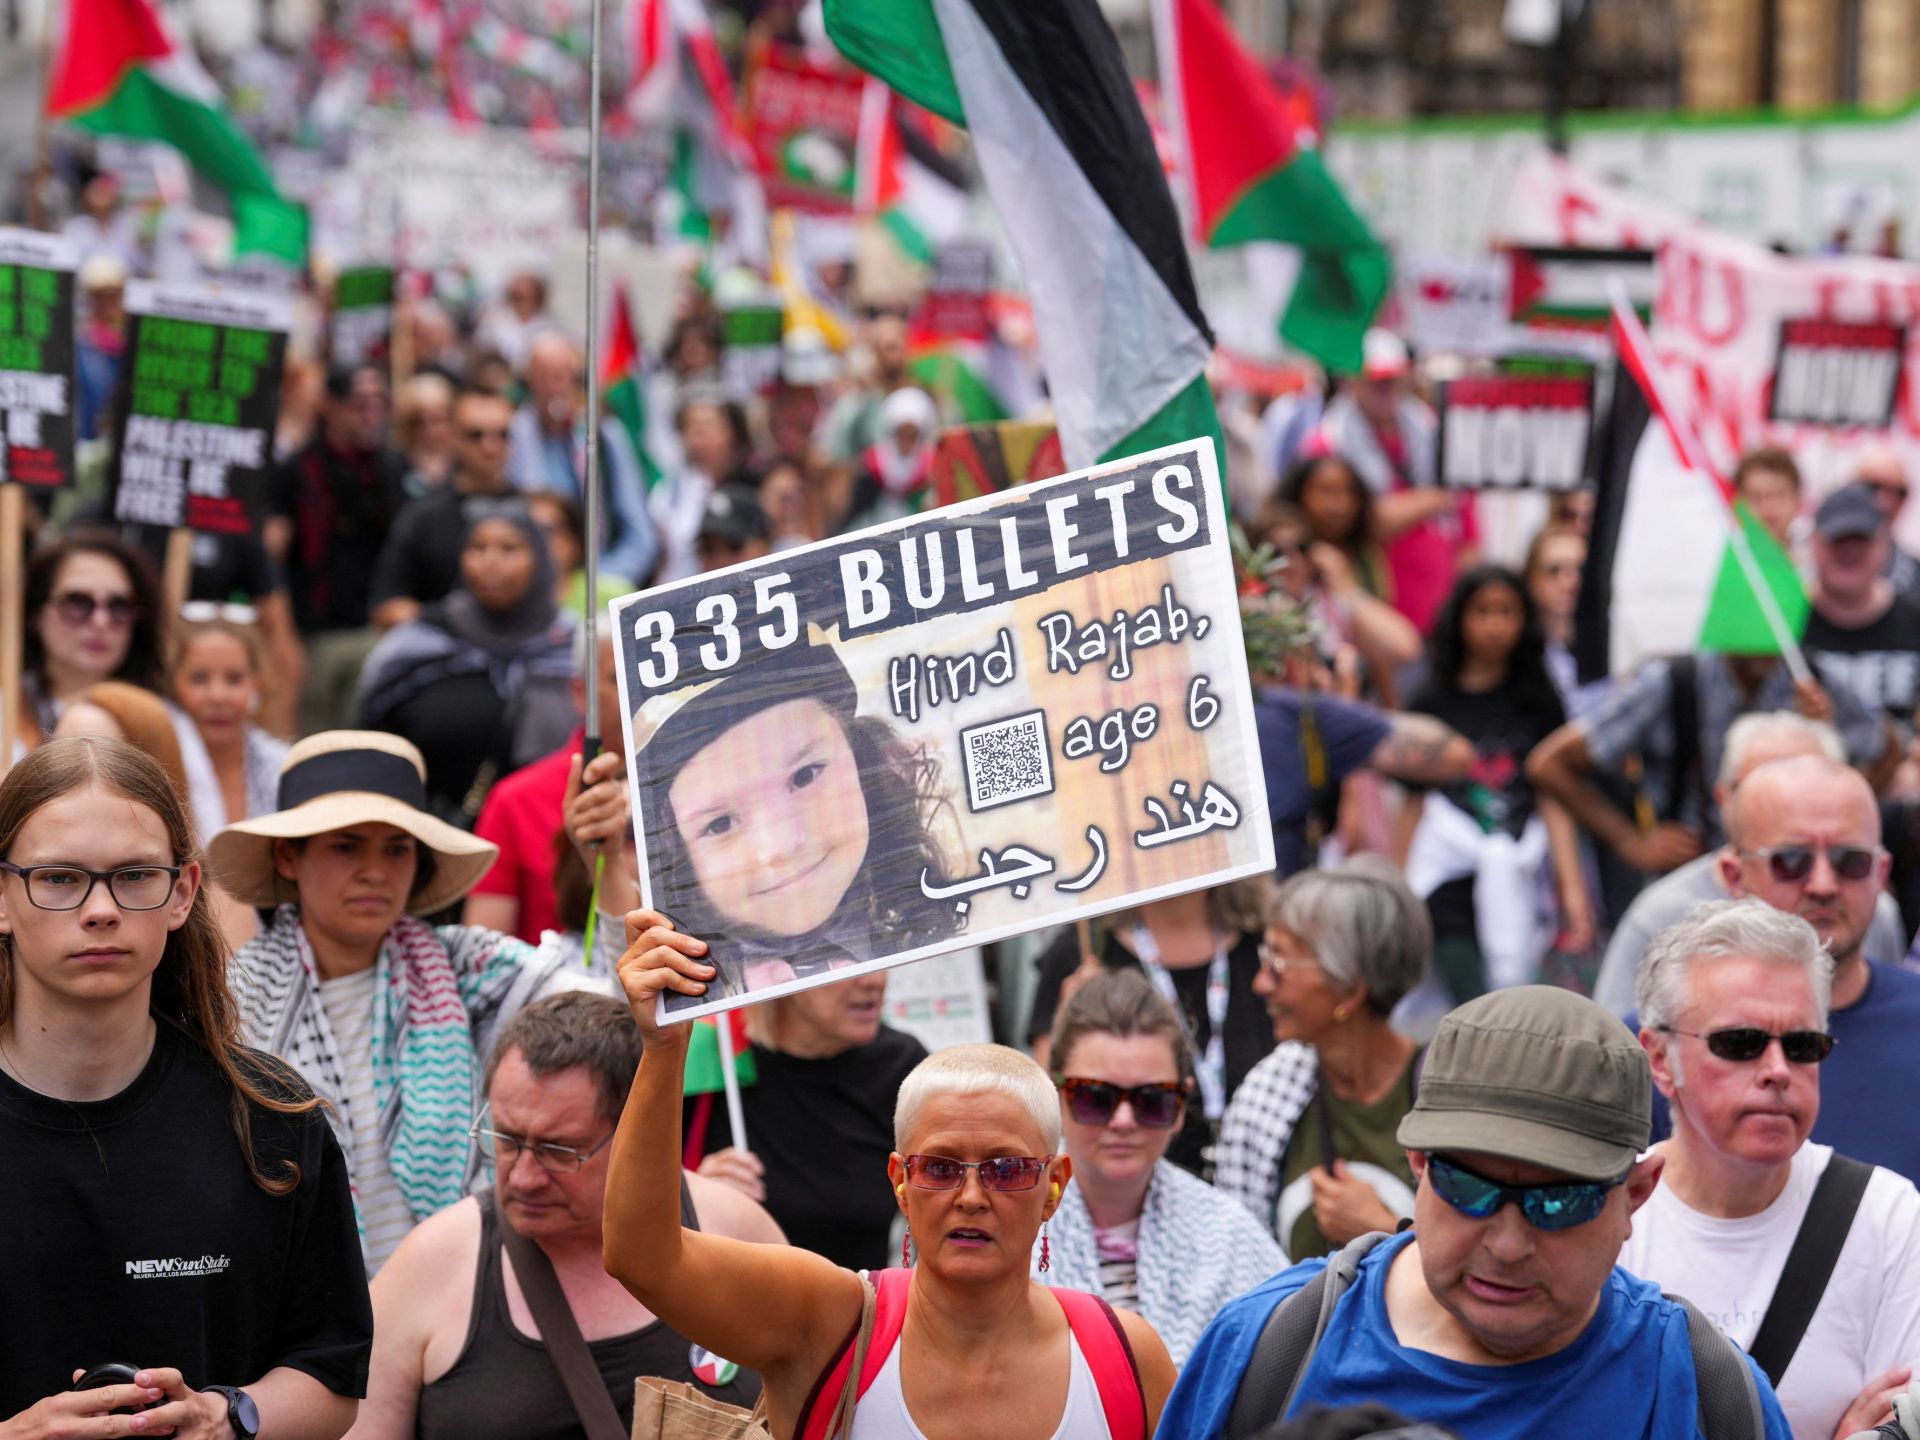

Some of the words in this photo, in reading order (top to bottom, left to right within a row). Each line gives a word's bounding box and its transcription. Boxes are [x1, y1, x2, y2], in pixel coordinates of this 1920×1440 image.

[1778, 344, 1899, 420] NOW
[120, 452, 183, 490] WILL
[187, 459, 229, 499] BE
[123, 413, 267, 469] PALESTINE
[1442, 405, 1590, 486] NOW
[115, 484, 184, 527] FREE
[634, 571, 799, 688] 335
[839, 464, 1199, 629] BULLETS
[889, 628, 1016, 722] Hind
[1038, 584, 1211, 680] Rajab,
[1062, 704, 1159, 773] age
[1187, 674, 1221, 730] 6
[1135, 780, 1241, 850] هند
[920, 825, 1108, 915] رجب
[125, 1259, 174, 1275] NEW
